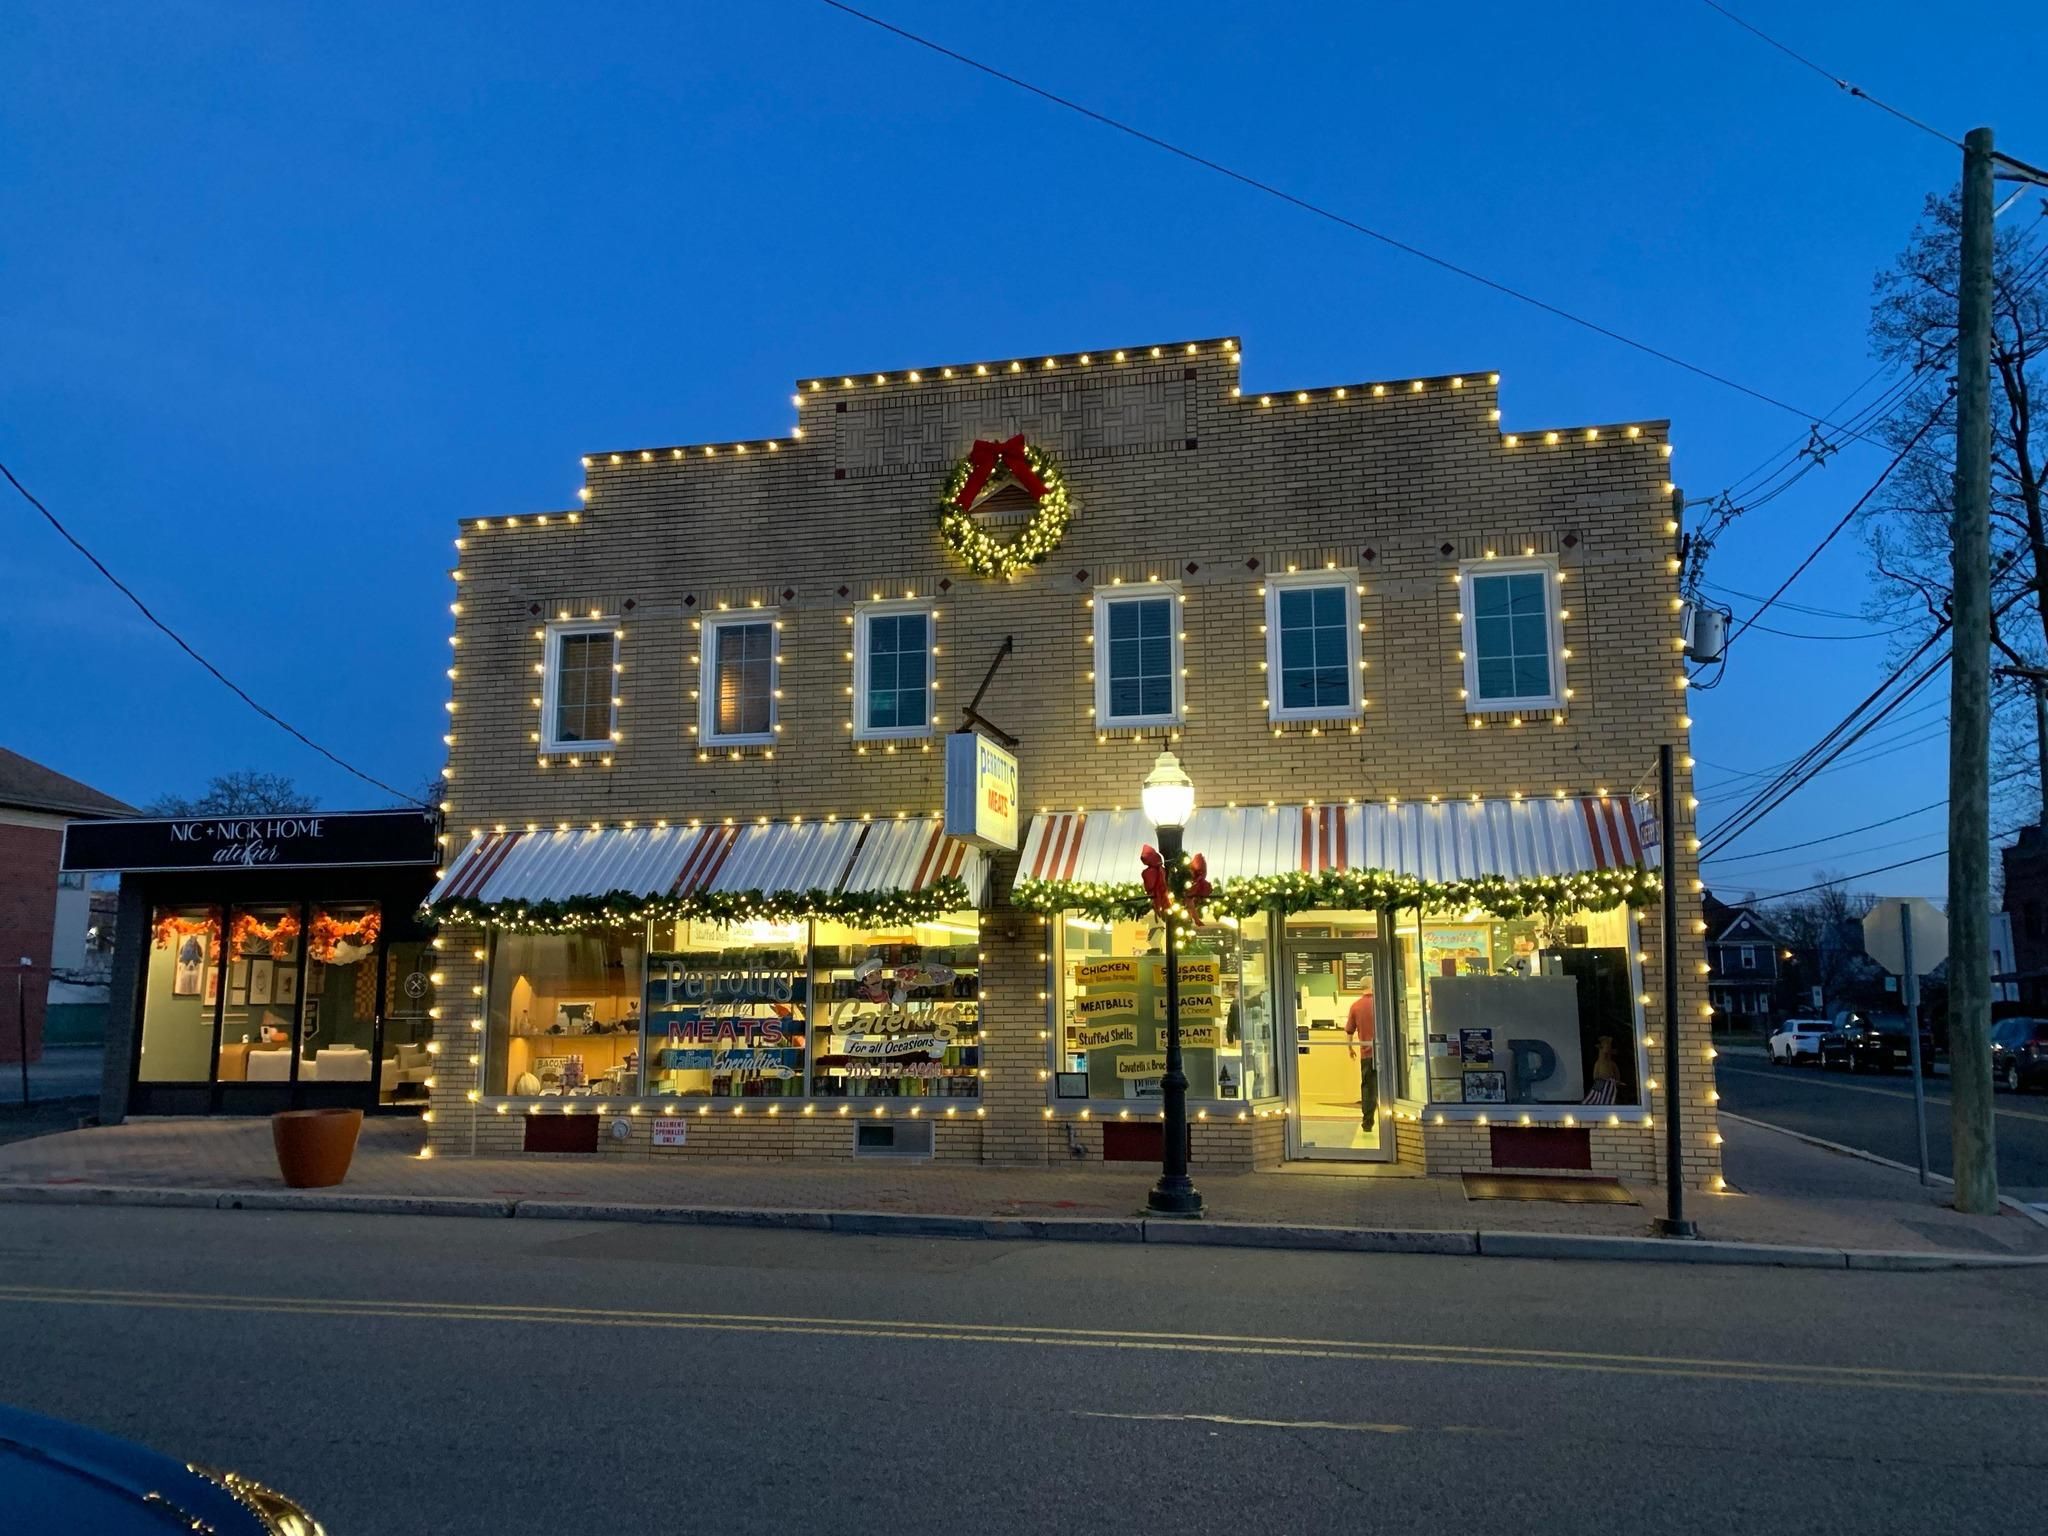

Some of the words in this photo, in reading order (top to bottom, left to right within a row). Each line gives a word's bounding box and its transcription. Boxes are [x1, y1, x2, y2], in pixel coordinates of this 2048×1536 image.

[988, 788, 1009, 818] MEATS
[170, 823, 202, 841] NIC
[206, 826, 215, 836] +
[217, 821, 262, 840] NICK
[267, 819, 325, 839] HOME
[212, 839, 279, 862] atelier
[1081, 963, 1130, 976] CHICKEN
[1161, 964, 1211, 975] SUSAGE
[1177, 974, 1214, 983] EPPERS
[663, 956, 793, 1007] Perrotti's
[1081, 998, 1134, 1013] MEATBALLS
[1160, 997, 1213, 1009] LAGNA
[832, 998, 963, 1041] Catering
[668, 1019, 784, 1045] MEATS
[1079, 1030, 1110, 1045] Stuffed
[1110, 1028, 1133, 1042] Shells
[1161, 1029, 1212, 1039] EPLANT
[848, 1042, 867, 1054] for
[868, 1042, 883, 1054] all
[884, 1038, 935, 1054] Occasions
[664, 1049, 712, 1069] Italian
[1508, 1039, 1556, 1103] P
